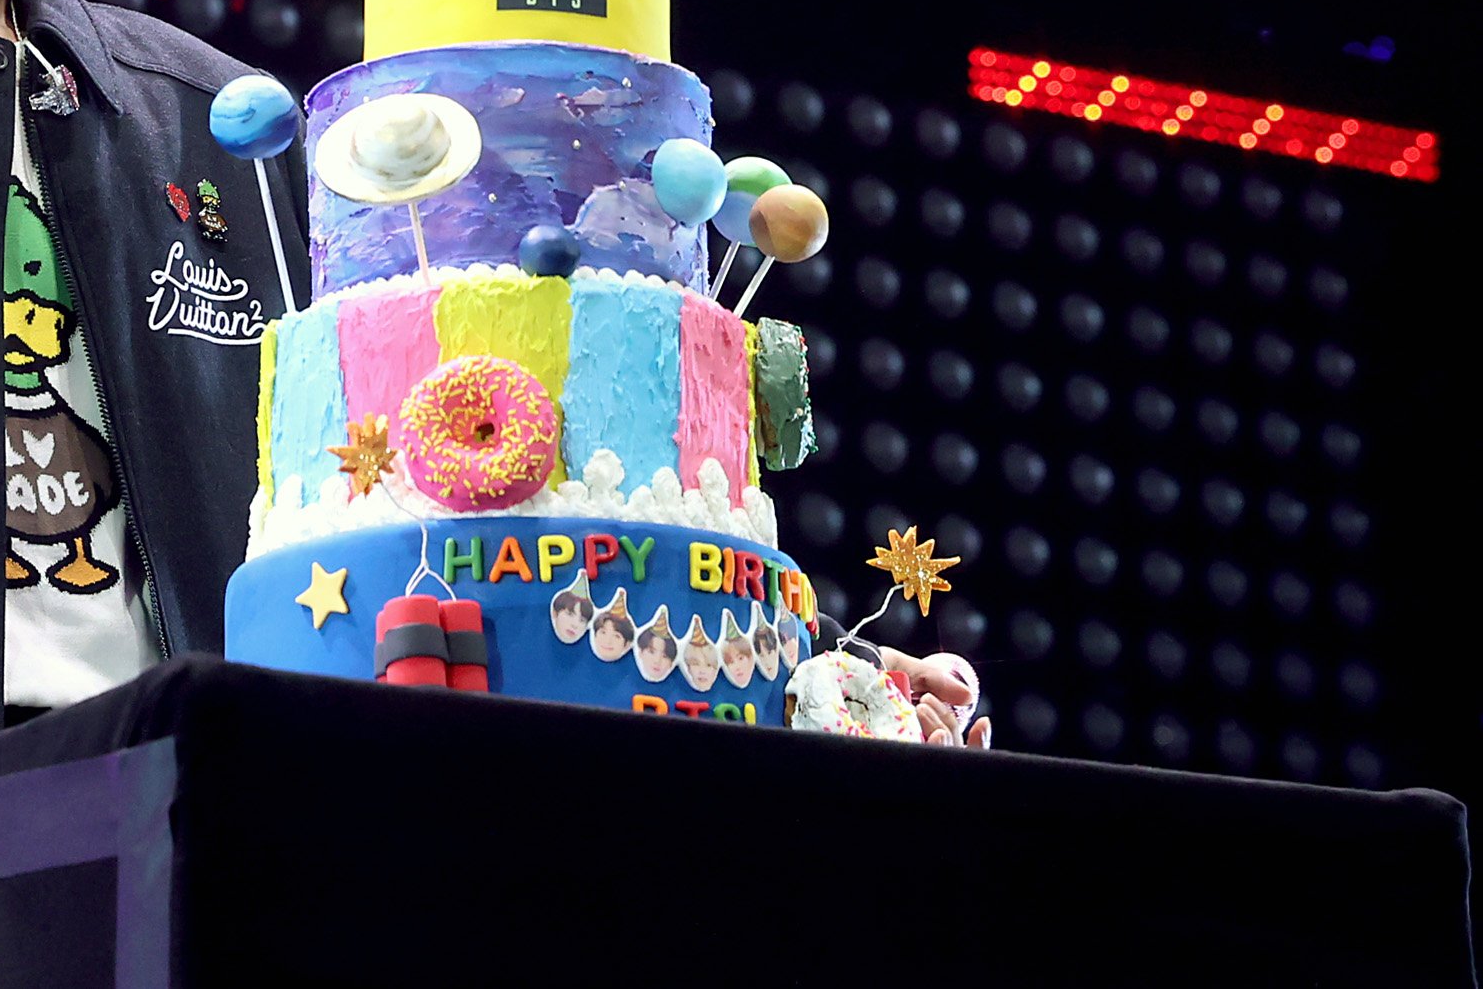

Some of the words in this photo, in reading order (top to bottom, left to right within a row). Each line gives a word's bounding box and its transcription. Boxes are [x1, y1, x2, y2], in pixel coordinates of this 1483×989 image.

[151, 241, 248, 301] Louis
[5, 471, 90, 515] ADE
[443, 533, 655, 583] HAPPY
[689, 541, 820, 640] BIRTHD
